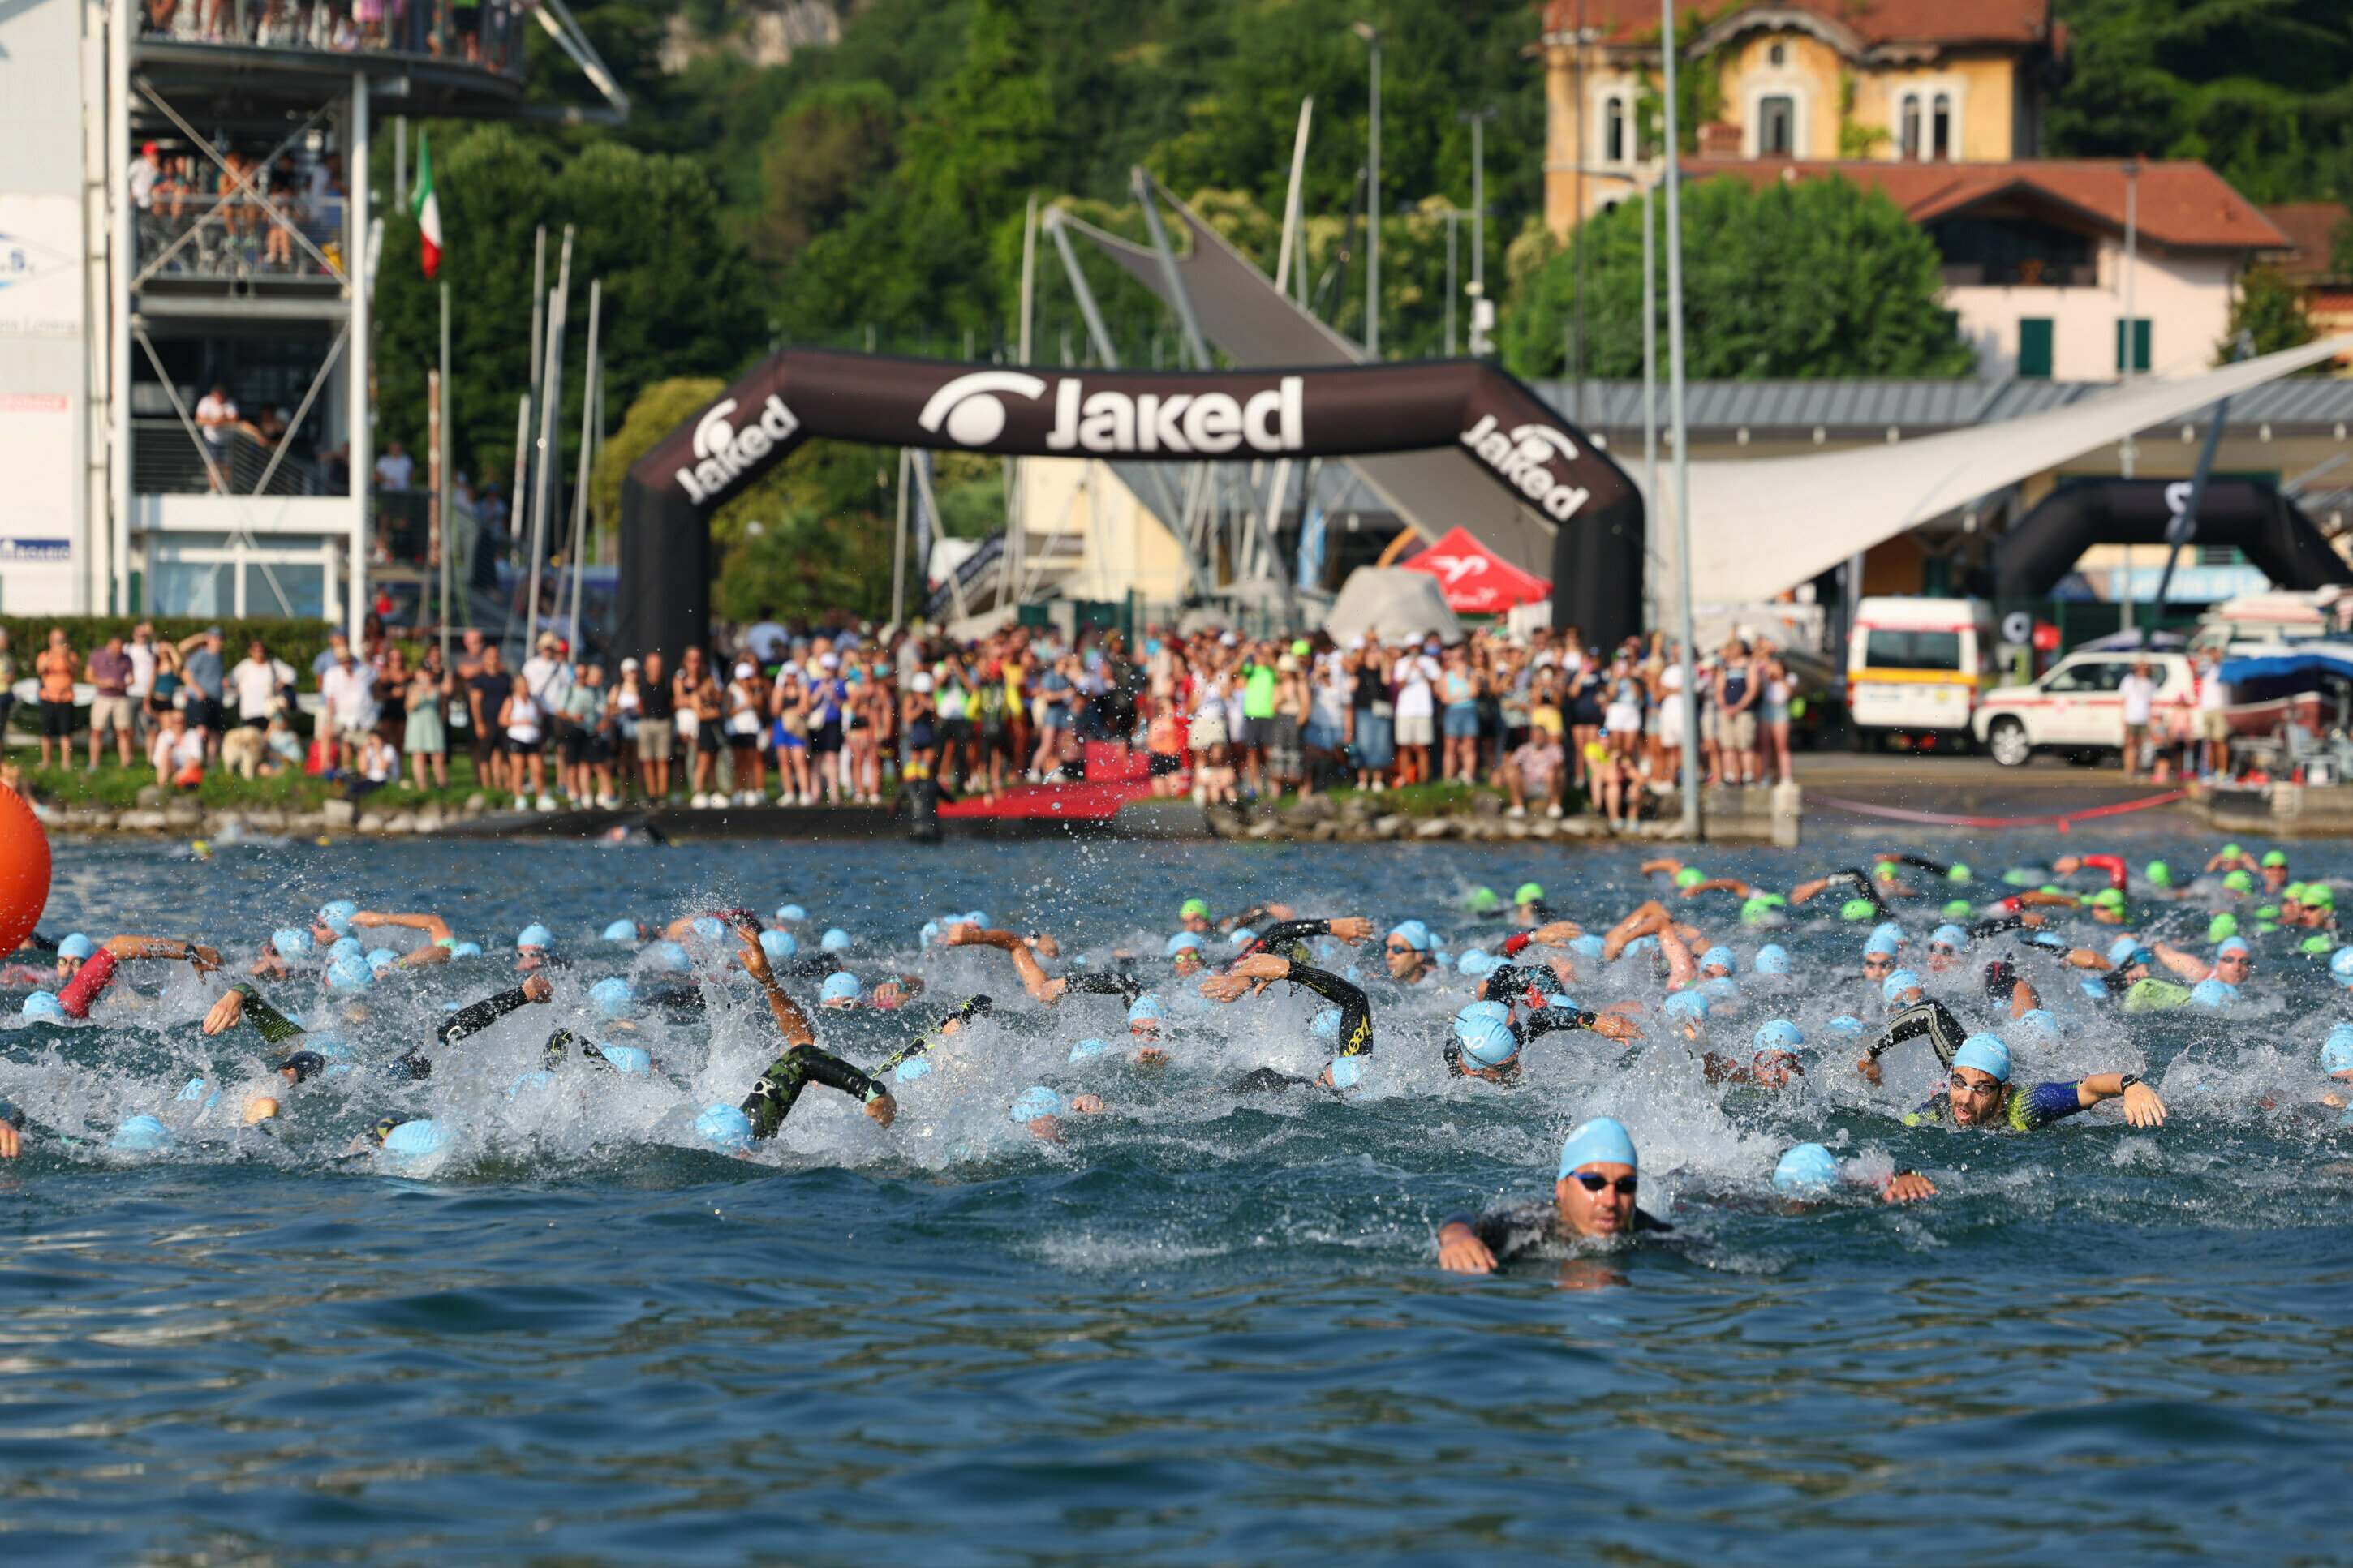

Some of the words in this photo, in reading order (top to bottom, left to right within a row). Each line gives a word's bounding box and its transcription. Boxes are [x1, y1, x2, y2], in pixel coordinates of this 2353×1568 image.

[675, 393, 800, 505] Jaked
[1046, 376, 1303, 453] Jaked
[1460, 414, 1590, 522] Jaked
